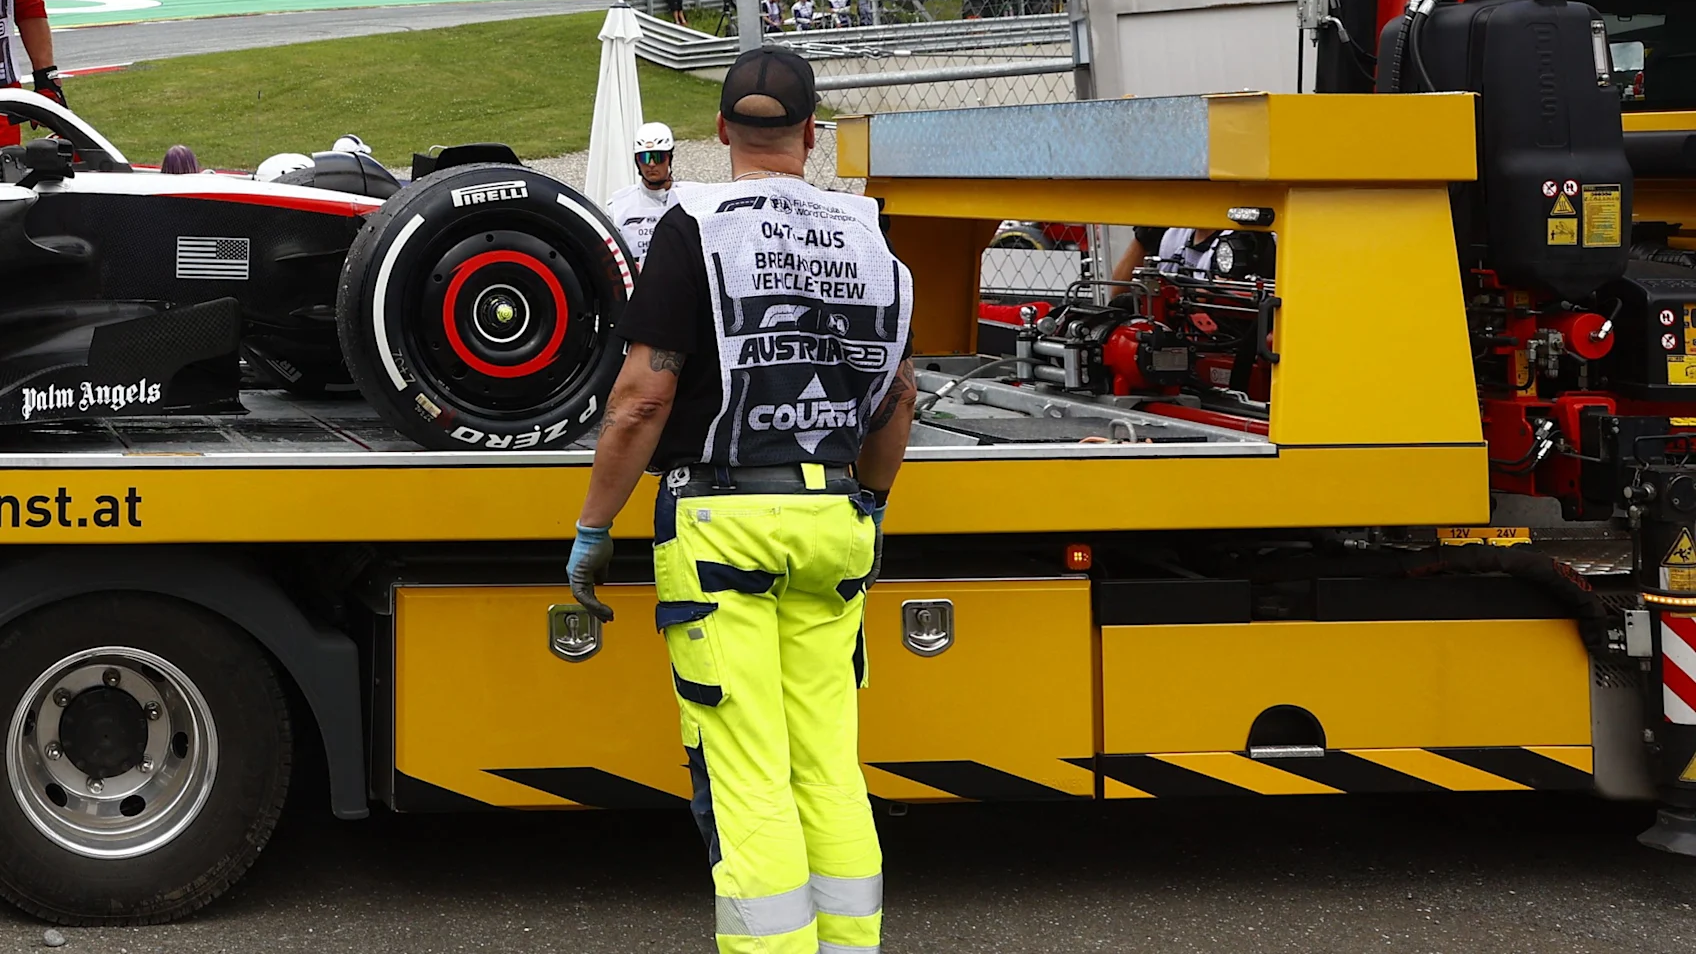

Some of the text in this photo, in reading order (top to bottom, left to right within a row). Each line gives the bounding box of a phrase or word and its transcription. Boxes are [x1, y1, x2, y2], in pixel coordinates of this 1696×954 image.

[451, 181, 529, 207] PIRELLI
[761, 221, 845, 249] 047-AUS
[21, 378, 162, 420] Palm Angels
[451, 395, 597, 449] P ZERO
[1450, 528, 1517, 539] 12V 24V
